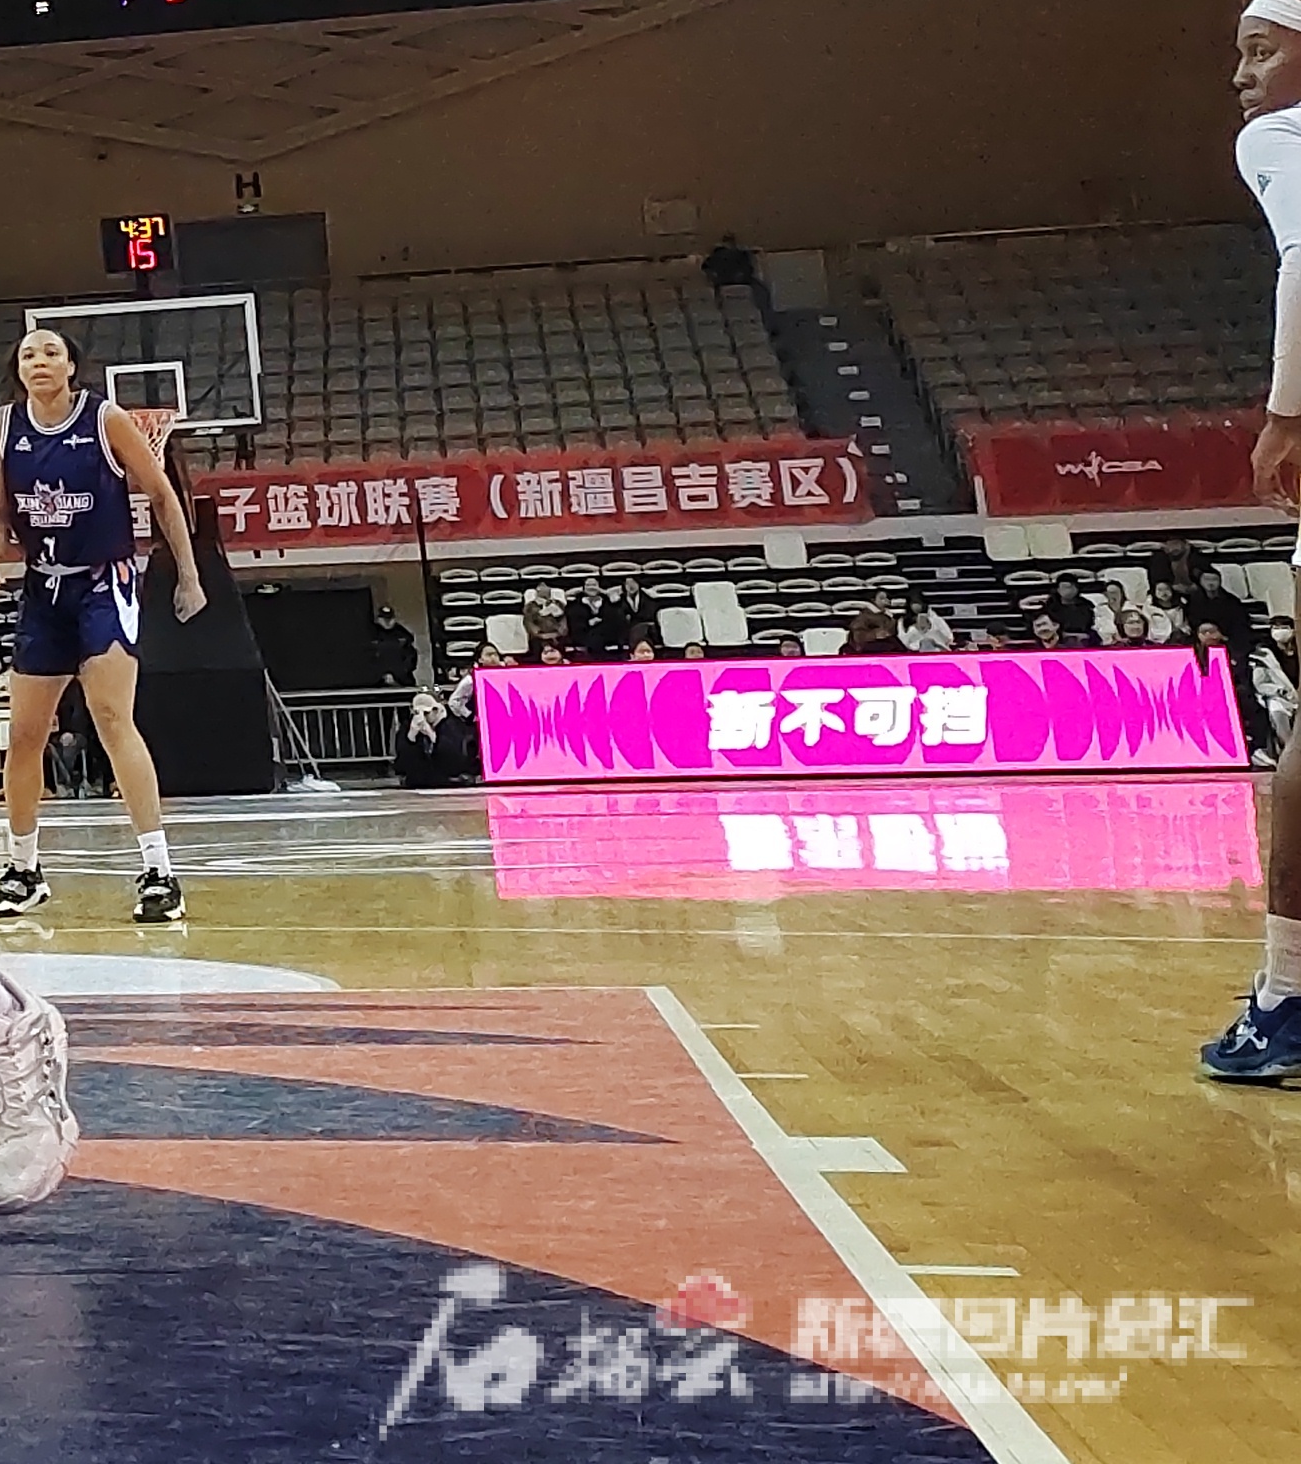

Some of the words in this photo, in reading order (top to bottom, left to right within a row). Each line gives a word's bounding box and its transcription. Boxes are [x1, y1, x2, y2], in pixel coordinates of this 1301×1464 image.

[235, 172, 262, 198] H
[119, 216, 166, 239] 4:37
[128, 239, 158, 270] 15
[1057, 457, 1164, 477] WCBA
[706, 684, 989, 751] 新不可挡
